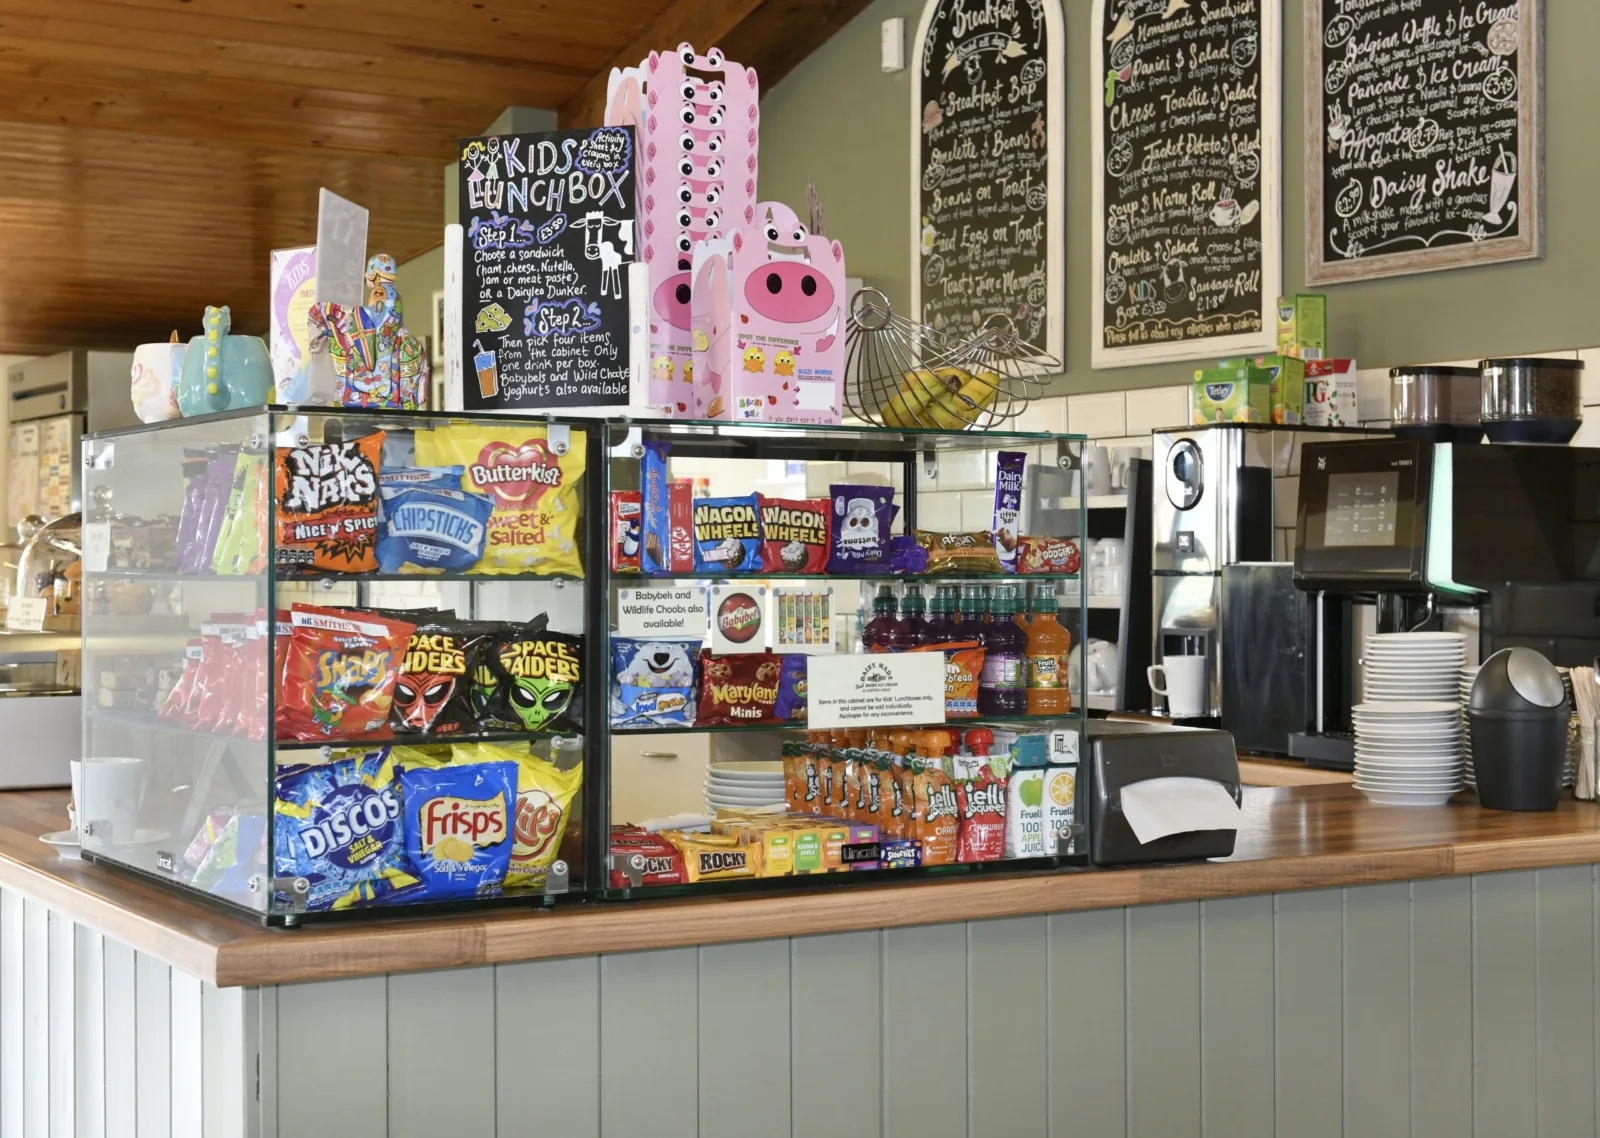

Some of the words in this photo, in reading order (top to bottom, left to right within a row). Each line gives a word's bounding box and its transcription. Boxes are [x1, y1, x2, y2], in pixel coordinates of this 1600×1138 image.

[1137, 10, 1195, 41] Homemade
[1201, 0, 1256, 24] Sandwich
[1346, 31, 1400, 62] Belgian
[1402, 14, 1441, 44] Waffle
[1458, 6, 1475, 30] Ice
[1476, 2, 1519, 23] Cream
[1131, 55, 1170, 86] Panini
[1189, 40, 1229, 69] Salad
[1349, 73, 1410, 107] Pancake
[1430, 63, 1448, 84] Ice
[1453, 55, 1500, 80] Cream
[946, 79, 1004, 117] Breakfast
[1008, 75, 1036, 105] Bap
[1110, 102, 1156, 130] Cheese
[1161, 89, 1209, 114] Toastie
[1220, 73, 1258, 111] Salad
[503, 138, 577, 178] KIDS
[583, 150, 610, 162] crayons
[931, 137, 978, 166] Omelette
[992, 130, 1030, 157] Beans
[1142, 133, 1185, 171] Jacket
[1186, 133, 1220, 160] Potato
[1229, 129, 1261, 165] Salad
[581, 160, 601, 172] every
[468, 170, 630, 213] LUNCHBOX
[932, 188, 972, 214] Beans
[976, 185, 991, 200] on
[996, 169, 1033, 199] Toast
[1370, 172, 1427, 210] Daisy
[1432, 157, 1491, 196] Shake
[1108, 201, 1139, 228] Soup
[1152, 188, 1187, 211] Warm
[1191, 181, 1216, 205] Roll
[479, 226, 506, 247] Step
[540, 217, 563, 241] £3.50
[474, 249, 506, 262] Choose
[509, 251, 515, 259] a
[519, 244, 565, 261] sandwich
[541, 259, 575, 272] Nutella,
[481, 275, 499, 288] jam
[503, 276, 514, 284] or
[518, 274, 542, 284] meat
[545, 272, 578, 286] paste)
[1188, 276, 1235, 301] Sausage
[1233, 270, 1260, 297] Roll
[507, 286, 545, 303] Dairylea
[539, 307, 570, 334] Step
[498, 334, 523, 348] Then
[526, 334, 549, 351] pick
[553, 334, 577, 346] four
[580, 332, 611, 349] items
[497, 349, 522, 364] from
[530, 347, 547, 358] the
[594, 346, 618, 360] Only
[502, 361, 520, 372] one
[524, 357, 553, 370] drink
[556, 359, 573, 372] per
[500, 370, 546, 387] Babybels
[550, 369, 568, 382] and
[573, 367, 598, 381] Wild
[503, 383, 550, 401] yoghurts
[556, 384, 578, 396] also
[1209, 385, 1230, 397] Tetley
[1305, 381, 1326, 403] PG
[472, 462, 561, 485] Butterkist
[999, 471, 1023, 483] Dairy
[999, 481, 1021, 491] Milk
[395, 507, 478, 544] CHIPSTICKS
[761, 506, 825, 527] WAGON
[695, 523, 759, 541] WHEELS
[764, 525, 826, 543] WHEELS
[843, 536, 877, 545] buttons
[635, 591, 673, 601] Babybels
[675, 590, 691, 599] and
[622, 605, 654, 615] Wildlife
[656, 605, 686, 614] Choobs
[688, 604, 704, 613] also
[722, 609, 759, 629] Babybel
[643, 619, 685, 628] available!
[500, 641, 579, 663] SPACE
[860, 662, 876, 682] DAISY
[878, 662, 893, 681] MADE
[1036, 666, 1057, 675] Shoot
[1037, 659, 1054, 667] Fruit
[713, 680, 780, 704] Maryland
[730, 706, 762, 718] Minis
[300, 790, 400, 858] DISCOS
[348, 842, 382, 864] VINEGAR
[349, 839, 366, 853] SALT
[367, 835, 375, 843] &
[434, 864, 449, 873] Salt
[451, 864, 457, 872] &
[458, 863, 487, 873] Vinegar
[700, 852, 746, 870] ROCKY
